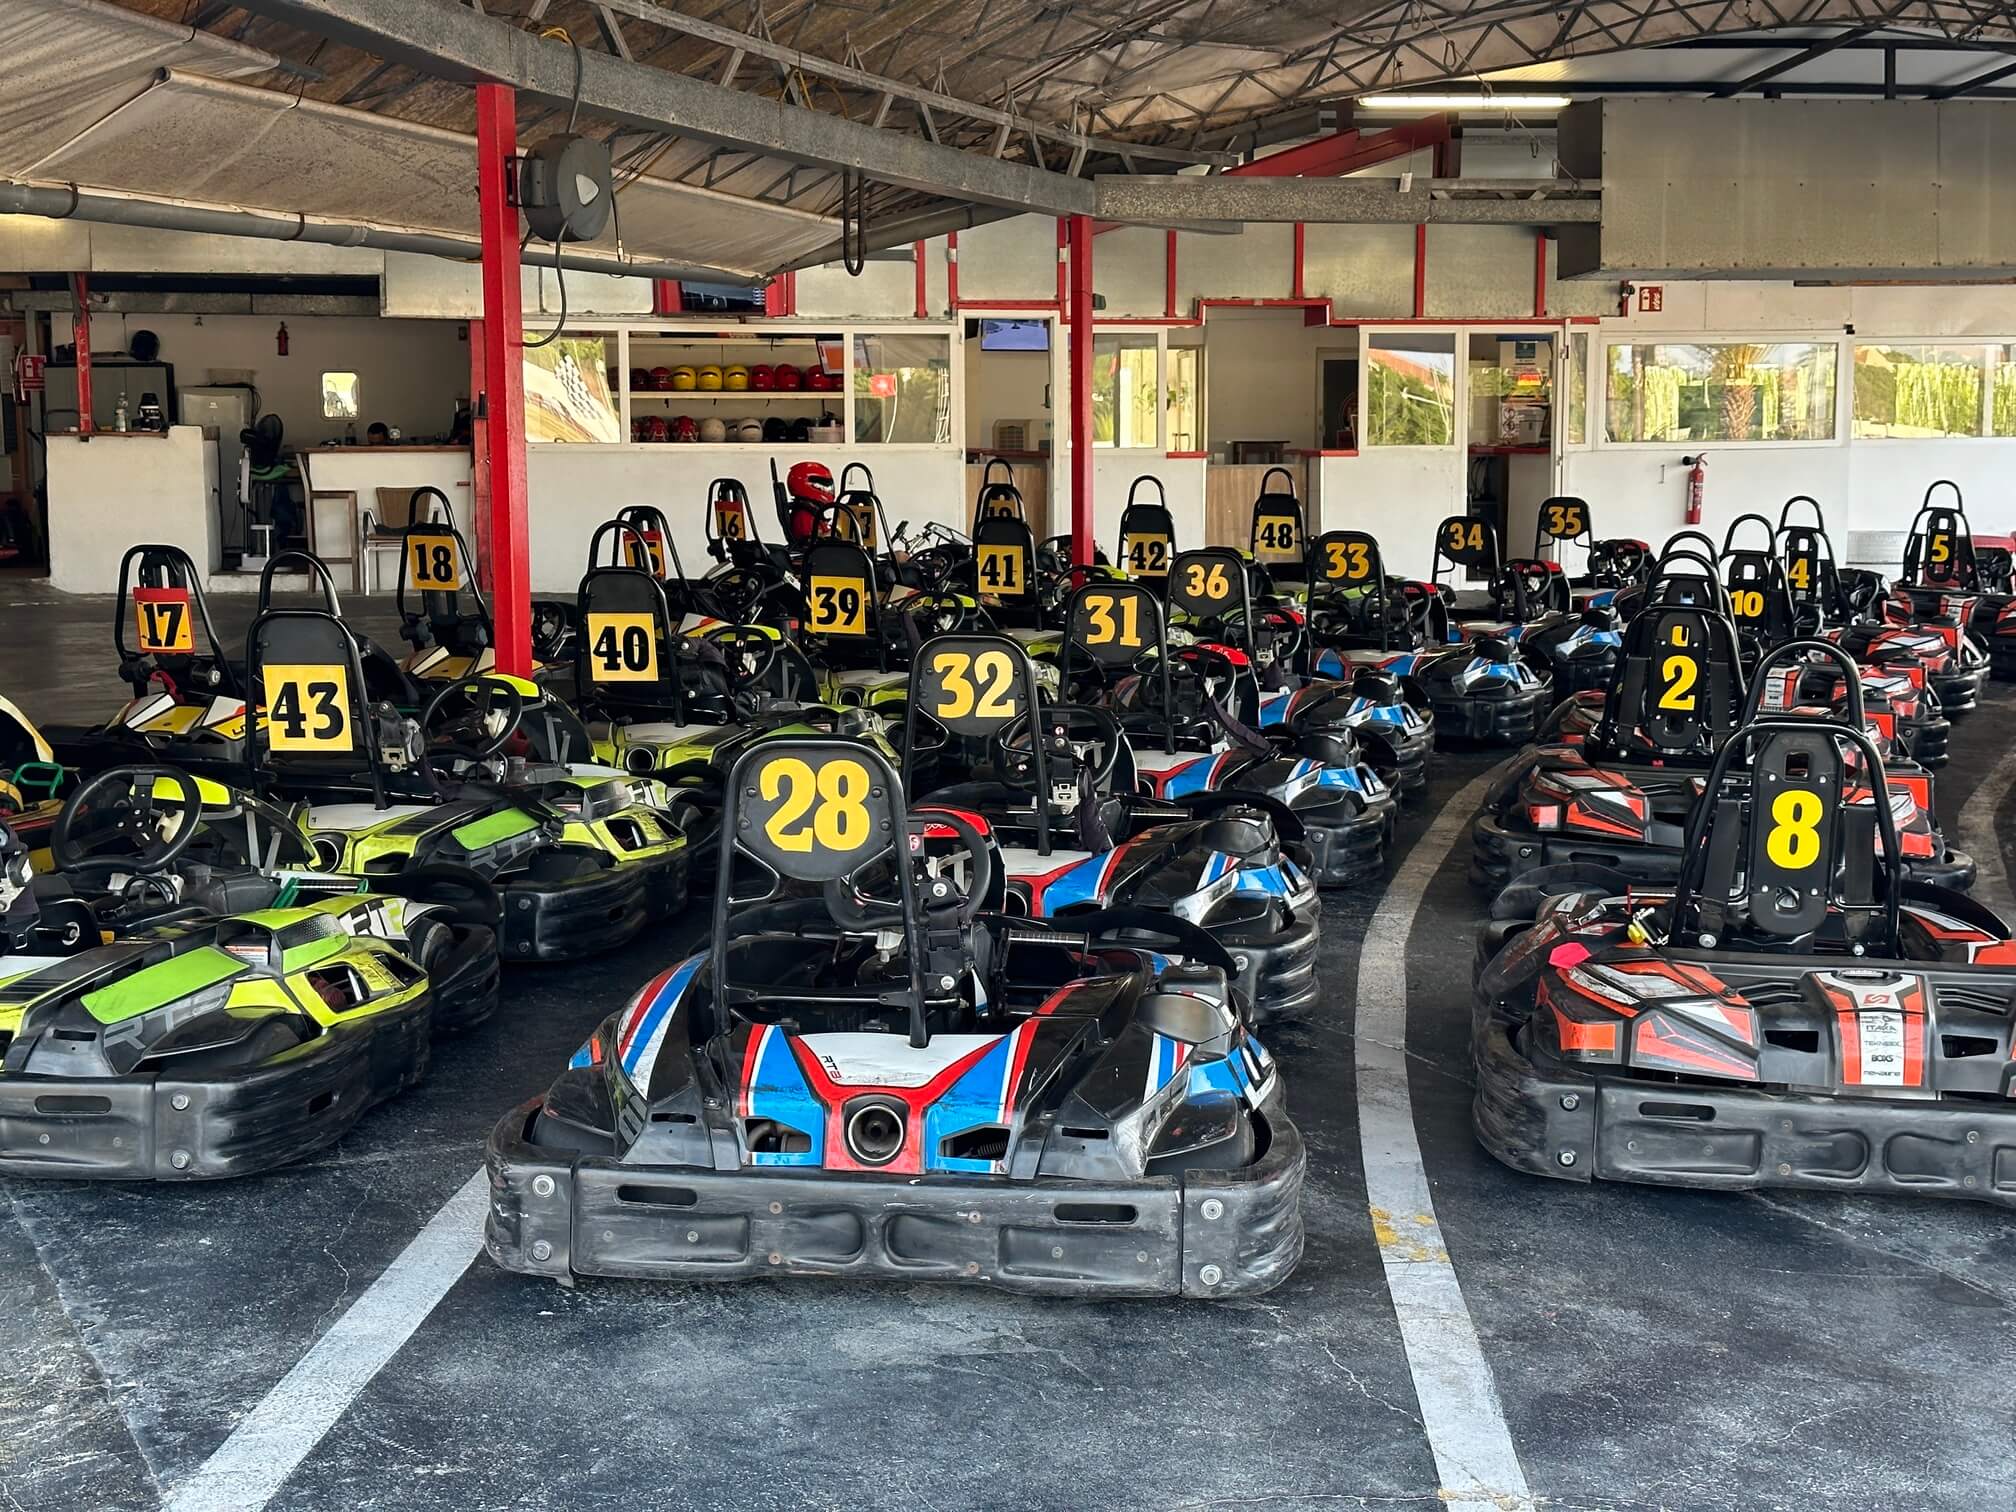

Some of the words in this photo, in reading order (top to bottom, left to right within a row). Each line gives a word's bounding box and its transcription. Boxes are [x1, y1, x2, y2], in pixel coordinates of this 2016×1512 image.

[720, 512, 739, 536] 16
[1261, 523, 1293, 549] 48
[1450, 523, 1484, 549] 34
[1549, 507, 1582, 534] 35
[415, 544, 452, 582] 18
[1129, 541, 1166, 571] 42
[1326, 543, 1370, 578] 33
[1931, 535, 1949, 562] 5
[980, 554, 1016, 587] 41
[1186, 564, 1230, 599] 36
[1788, 558, 1810, 588] 4
[815, 587, 859, 625] 39
[1731, 590, 1763, 617] 10
[144, 603, 184, 647] 17
[1085, 596, 1142, 647] 31
[593, 626, 650, 671] 40
[933, 653, 1014, 718] 32
[1659, 655, 1698, 710] 2
[271, 682, 344, 739] 43
[760, 758, 872, 852] 28
[1767, 790, 1823, 869] 8
